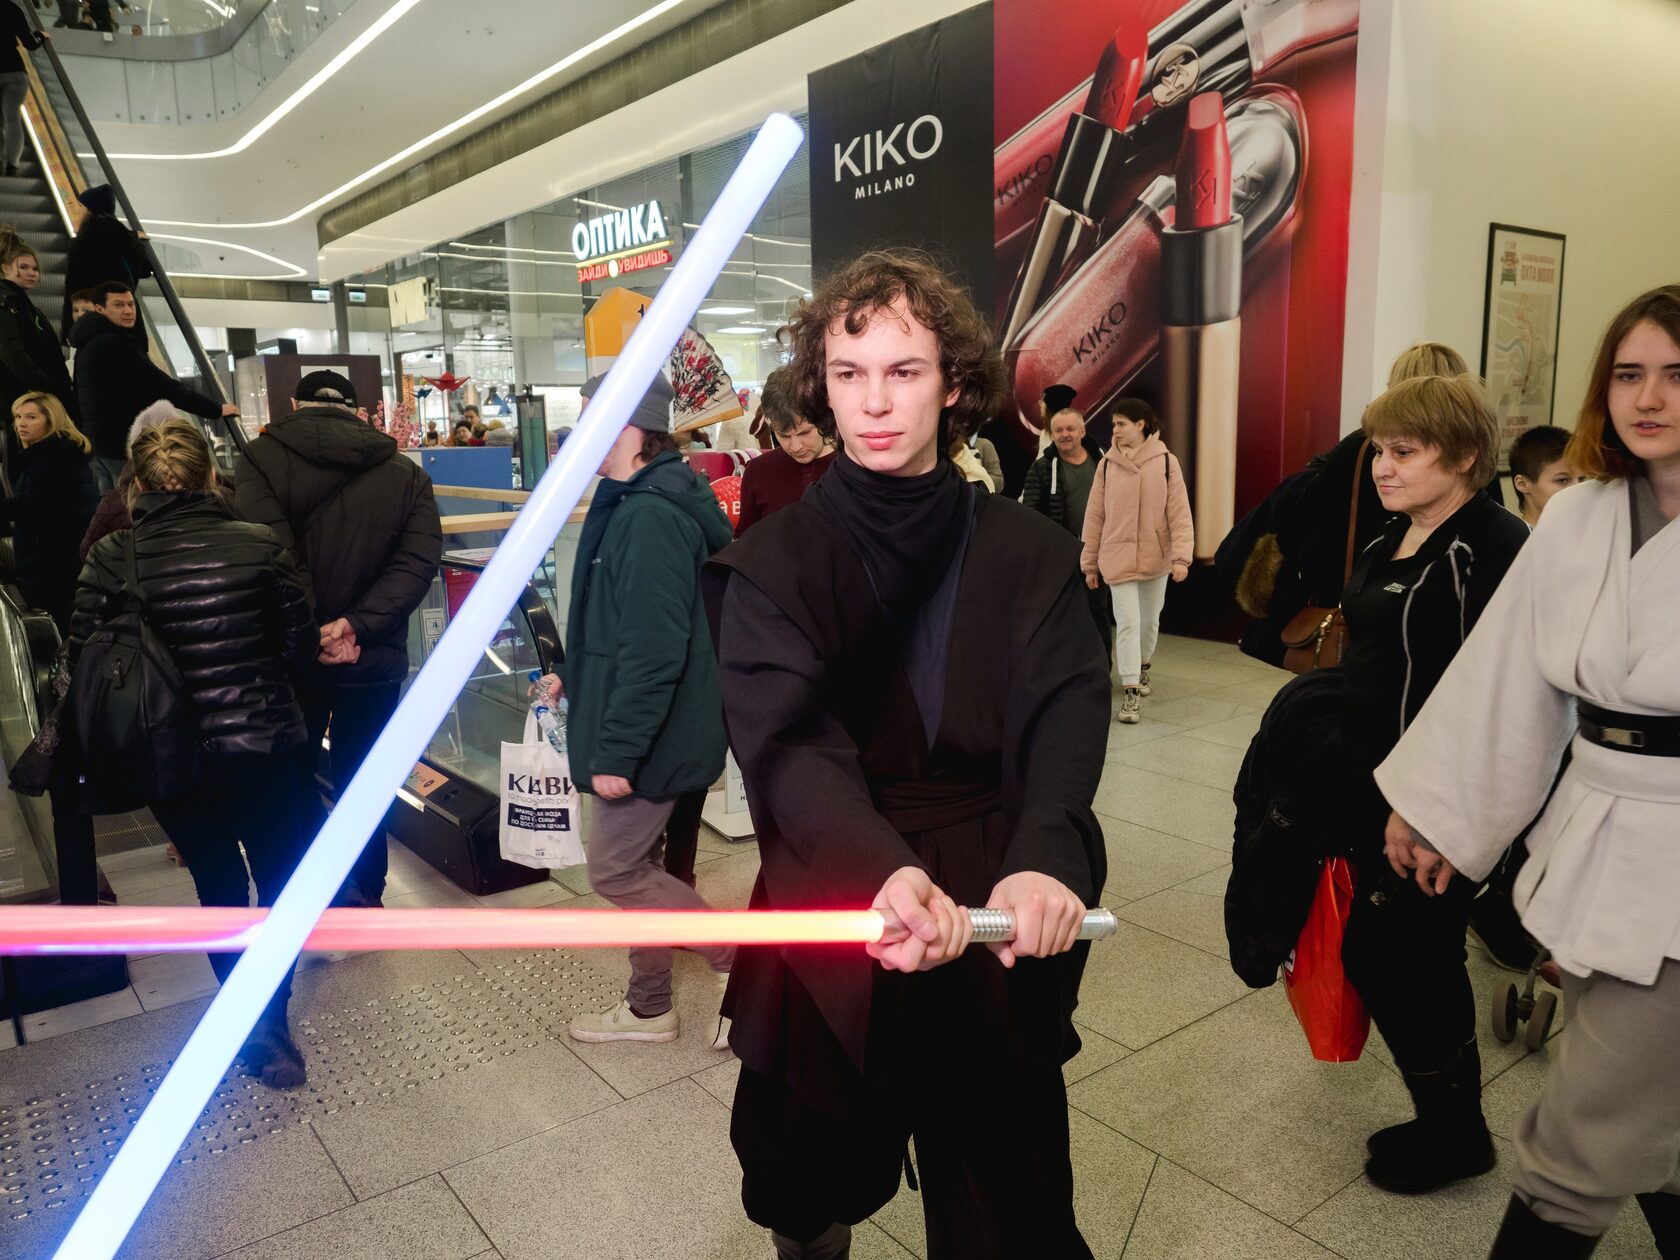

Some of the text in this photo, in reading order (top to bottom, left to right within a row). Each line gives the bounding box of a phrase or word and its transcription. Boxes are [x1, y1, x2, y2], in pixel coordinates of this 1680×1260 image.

[834, 114, 943, 182] KIKO
[855, 173, 915, 200] MILANO
[997, 154, 1053, 206] KIKO
[572, 200, 668, 260] ОПТИКА
[577, 249, 669, 282] ЗАЙДИ УВИДИШЬ
[1073, 302, 1126, 363] KIKO
